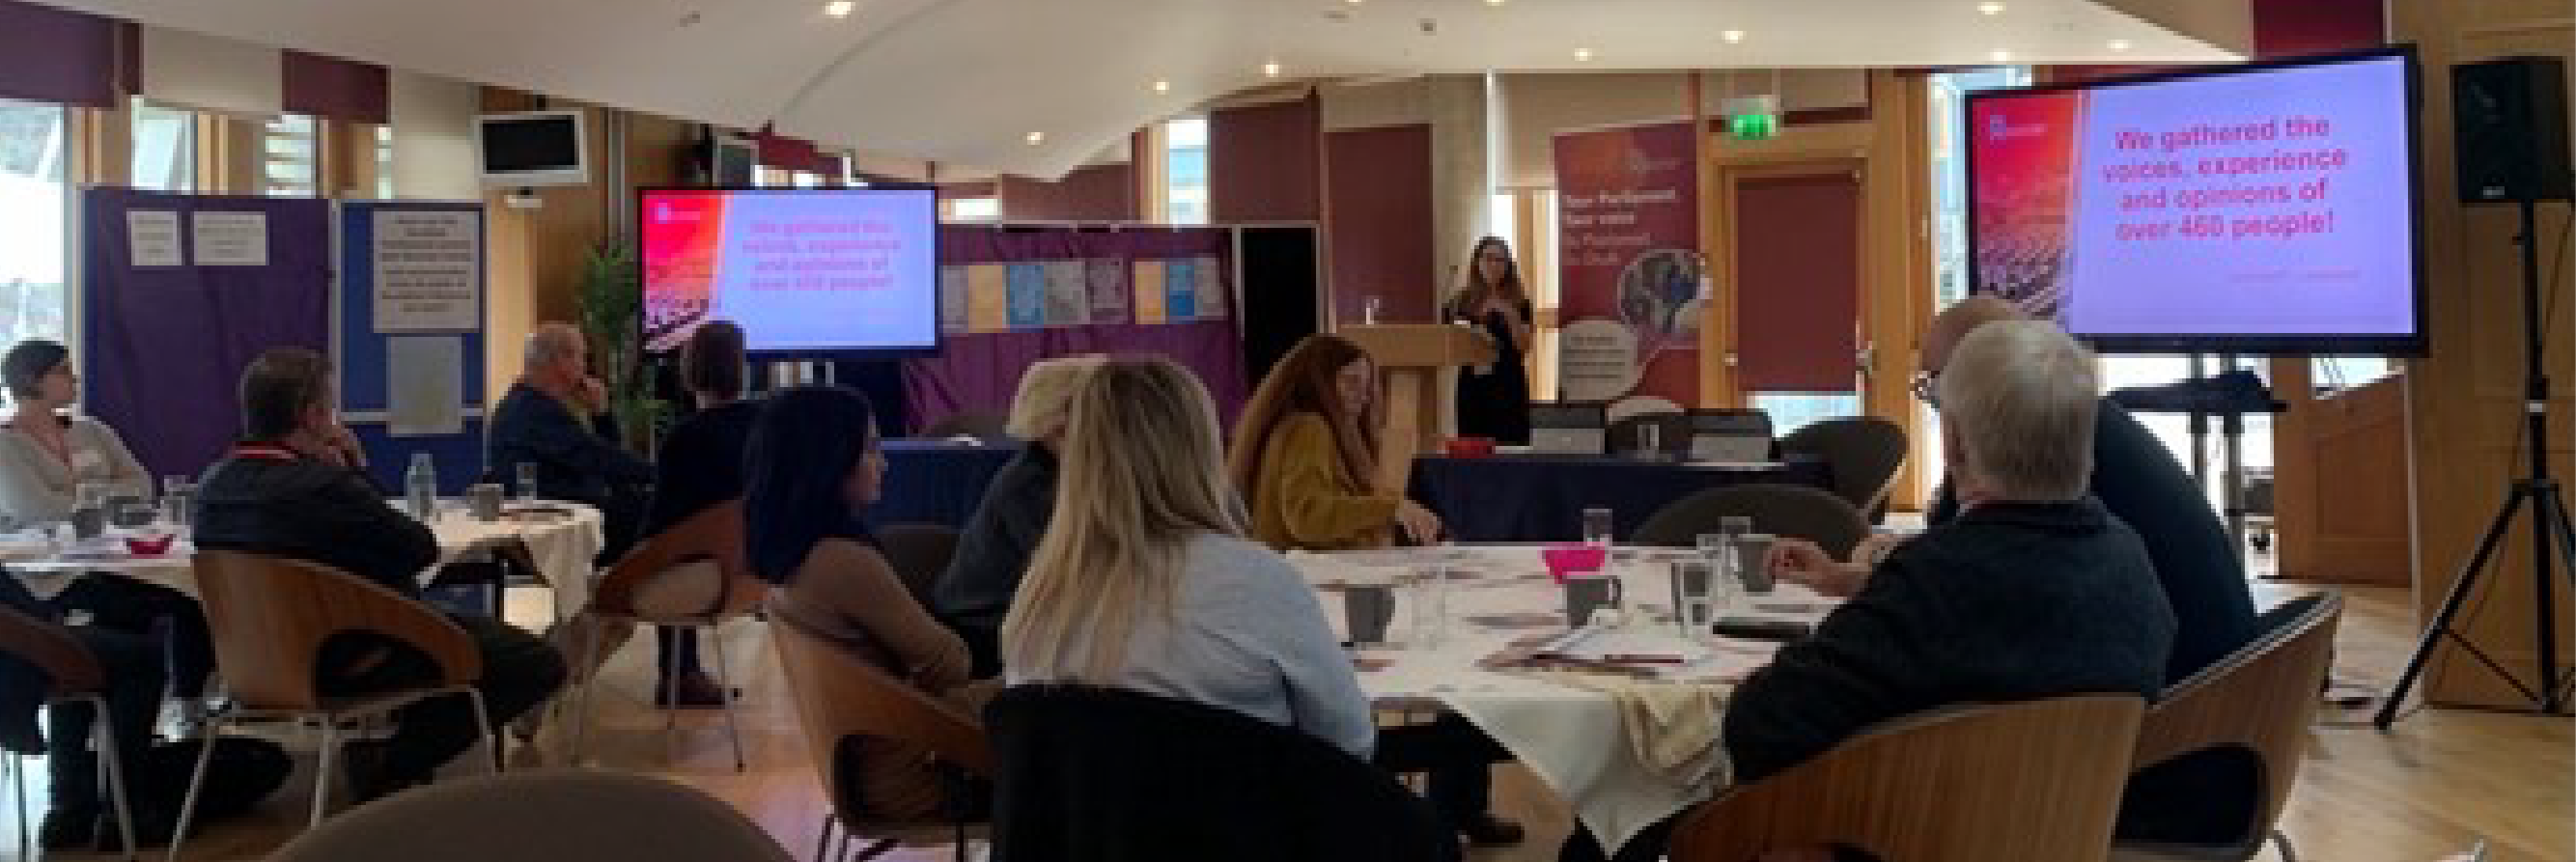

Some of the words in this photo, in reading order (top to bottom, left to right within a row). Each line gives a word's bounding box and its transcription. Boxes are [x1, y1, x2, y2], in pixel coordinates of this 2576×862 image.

[2114, 127, 2153, 151] We
[2160, 118, 2275, 153] gathered
[2284, 115, 2330, 137] the
[2198, 148, 2346, 178] experience
[2121, 186, 2166, 210] and
[2174, 183, 2291, 211] opinions
[2298, 176, 2328, 203] of
[2114, 222, 2170, 241] over
[2231, 208, 2334, 241] people!
